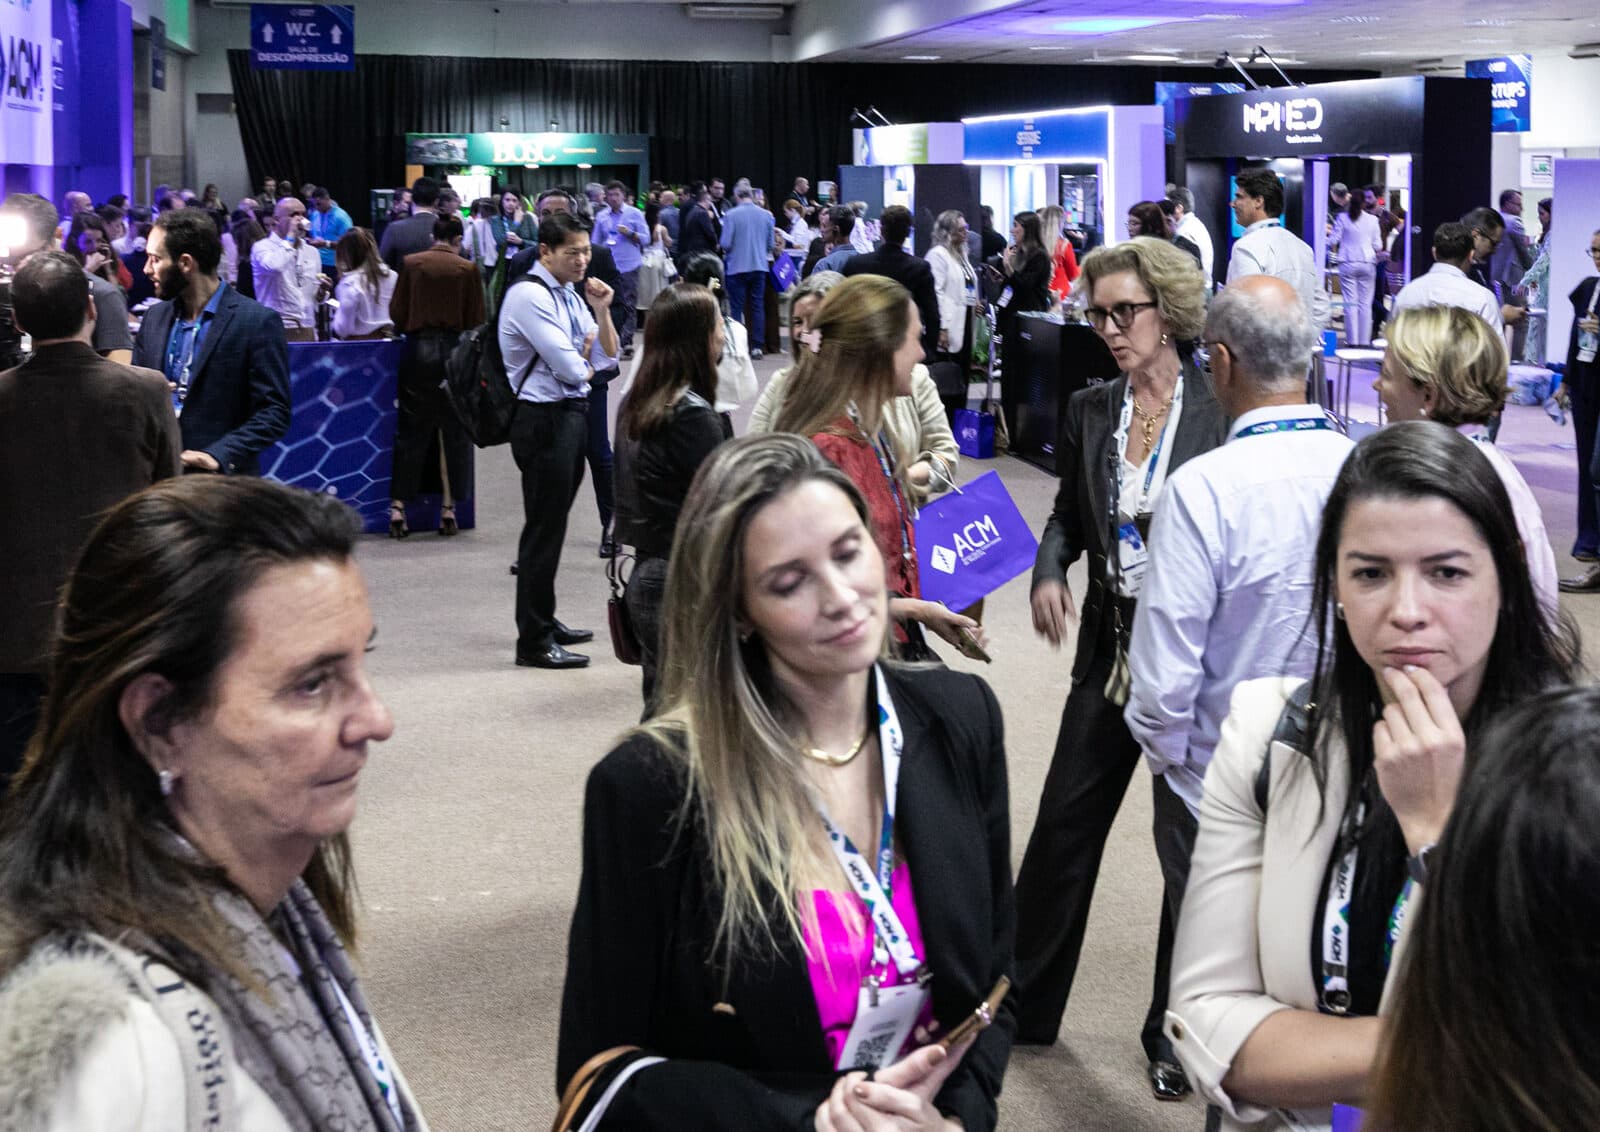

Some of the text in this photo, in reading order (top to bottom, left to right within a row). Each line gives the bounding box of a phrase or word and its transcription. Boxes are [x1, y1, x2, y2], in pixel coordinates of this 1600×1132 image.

[285, 22, 320, 36] W.C.
[258, 52, 349, 63] DESCOMPRESSÃO
[1491, 81, 1526, 99] RTUPS
[953, 514, 1000, 558] ACM
[1331, 936, 1342, 962] ACM
